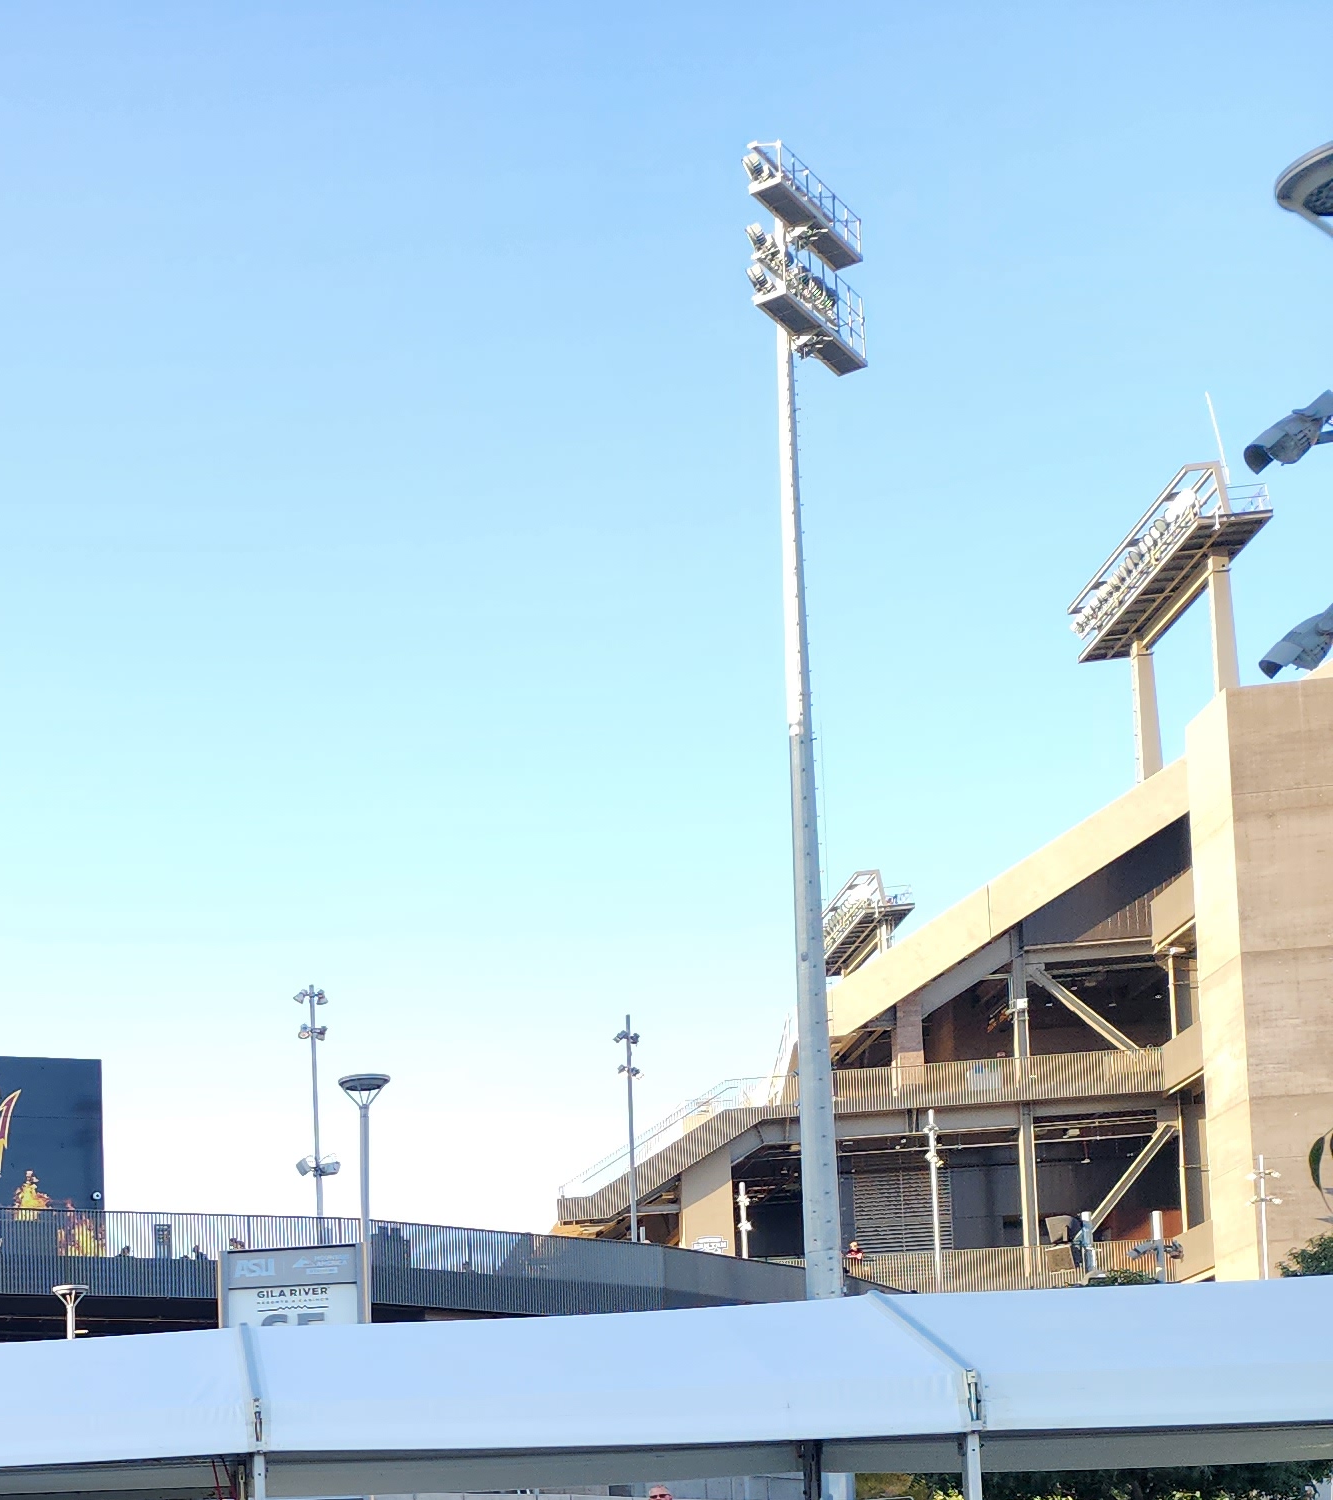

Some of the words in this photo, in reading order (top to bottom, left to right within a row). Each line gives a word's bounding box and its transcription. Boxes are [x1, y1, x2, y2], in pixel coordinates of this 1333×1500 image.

[235, 1258, 276, 1278] ASU
[257, 1290, 286, 1299] GILA
[290, 1287, 328, 1297] RIVER
